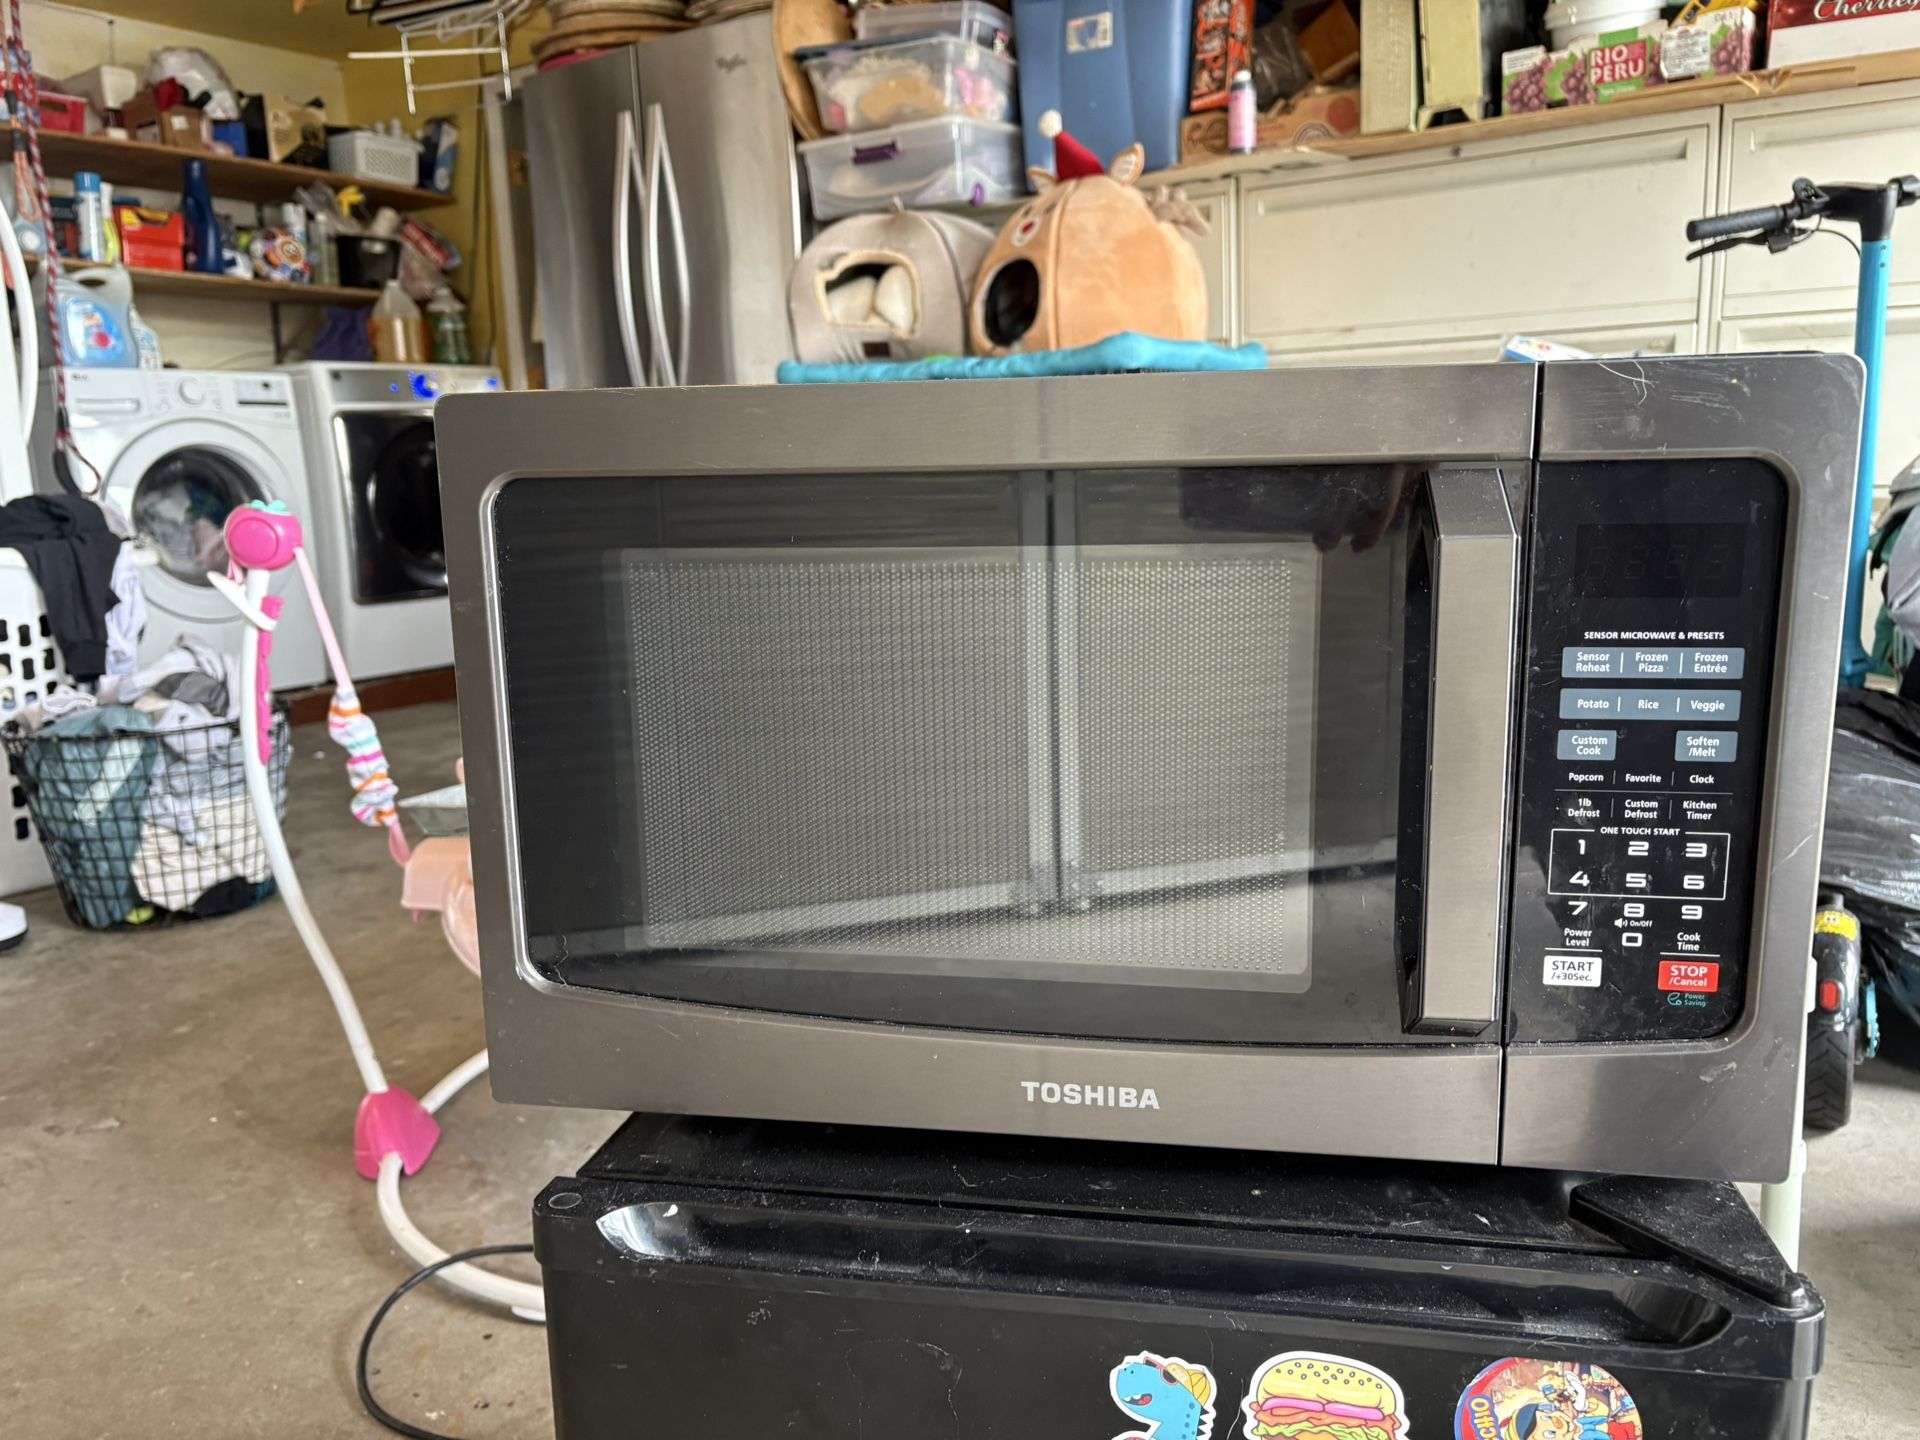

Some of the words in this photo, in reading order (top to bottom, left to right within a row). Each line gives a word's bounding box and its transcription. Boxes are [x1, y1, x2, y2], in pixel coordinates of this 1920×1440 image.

[1591, 45, 1628, 64] RIO
[1591, 58, 1644, 84] PERU
[1577, 652, 1610, 662] Sensor
[1635, 652, 1668, 662] Frozen
[1695, 653, 1728, 663] Frozen
[1576, 663, 1610, 672] Reheat
[1639, 664, 1664, 673] Pizza
[1694, 664, 1727, 673] Entrée
[1577, 700, 1609, 709] Potato
[1638, 700, 1659, 709] Rice
[1691, 701, 1725, 712] Veggie
[1571, 736, 1608, 746] Custom
[1686, 737, 1720, 747] Soften
[1577, 746, 1601, 755] Cook
[1688, 747, 1715, 757] /Melt
[1568, 773, 1604, 783] Popcorn
[1625, 773, 1662, 783] Favorite
[1689, 775, 1714, 784] Clock
[1578, 798, 1592, 807] 1lb
[1625, 799, 1658, 808] Custom
[1683, 800, 1717, 810] Kitchen
[1568, 808, 1600, 818] Defrost
[1624, 809, 1657, 819] Defrost
[1687, 811, 1712, 820] Timer
[1600, 827, 1619, 835] ONE
[1621, 827, 1651, 835] TOUCH
[1579, 840, 1586, 855] 1
[1628, 841, 1649, 856] 2
[1685, 843, 1708, 858] 3
[1569, 871, 1590, 887] 4
[1625, 873, 1647, 888] 5
[1683, 875, 1705, 890] 6
[1568, 901, 1588, 915] 7
[1624, 903, 1645, 918] 8
[1682, 905, 1702, 920] 9
[1630, 920, 1652, 928] On/Off
[1564, 929, 1592, 938] Power
[1677, 932, 1701, 942] Cook
[1566, 938, 1590, 947] Level
[1621, 932, 1643, 947] 0
[1677, 942, 1700, 951] Time
[1552, 961, 1594, 971] START
[1670, 966, 1708, 977] STOP
[1551, 972, 1592, 982] /+30Sec.
[1669, 977, 1707, 987] /Cancel
[1020, 1081, 1160, 1109] TOSHIBA
